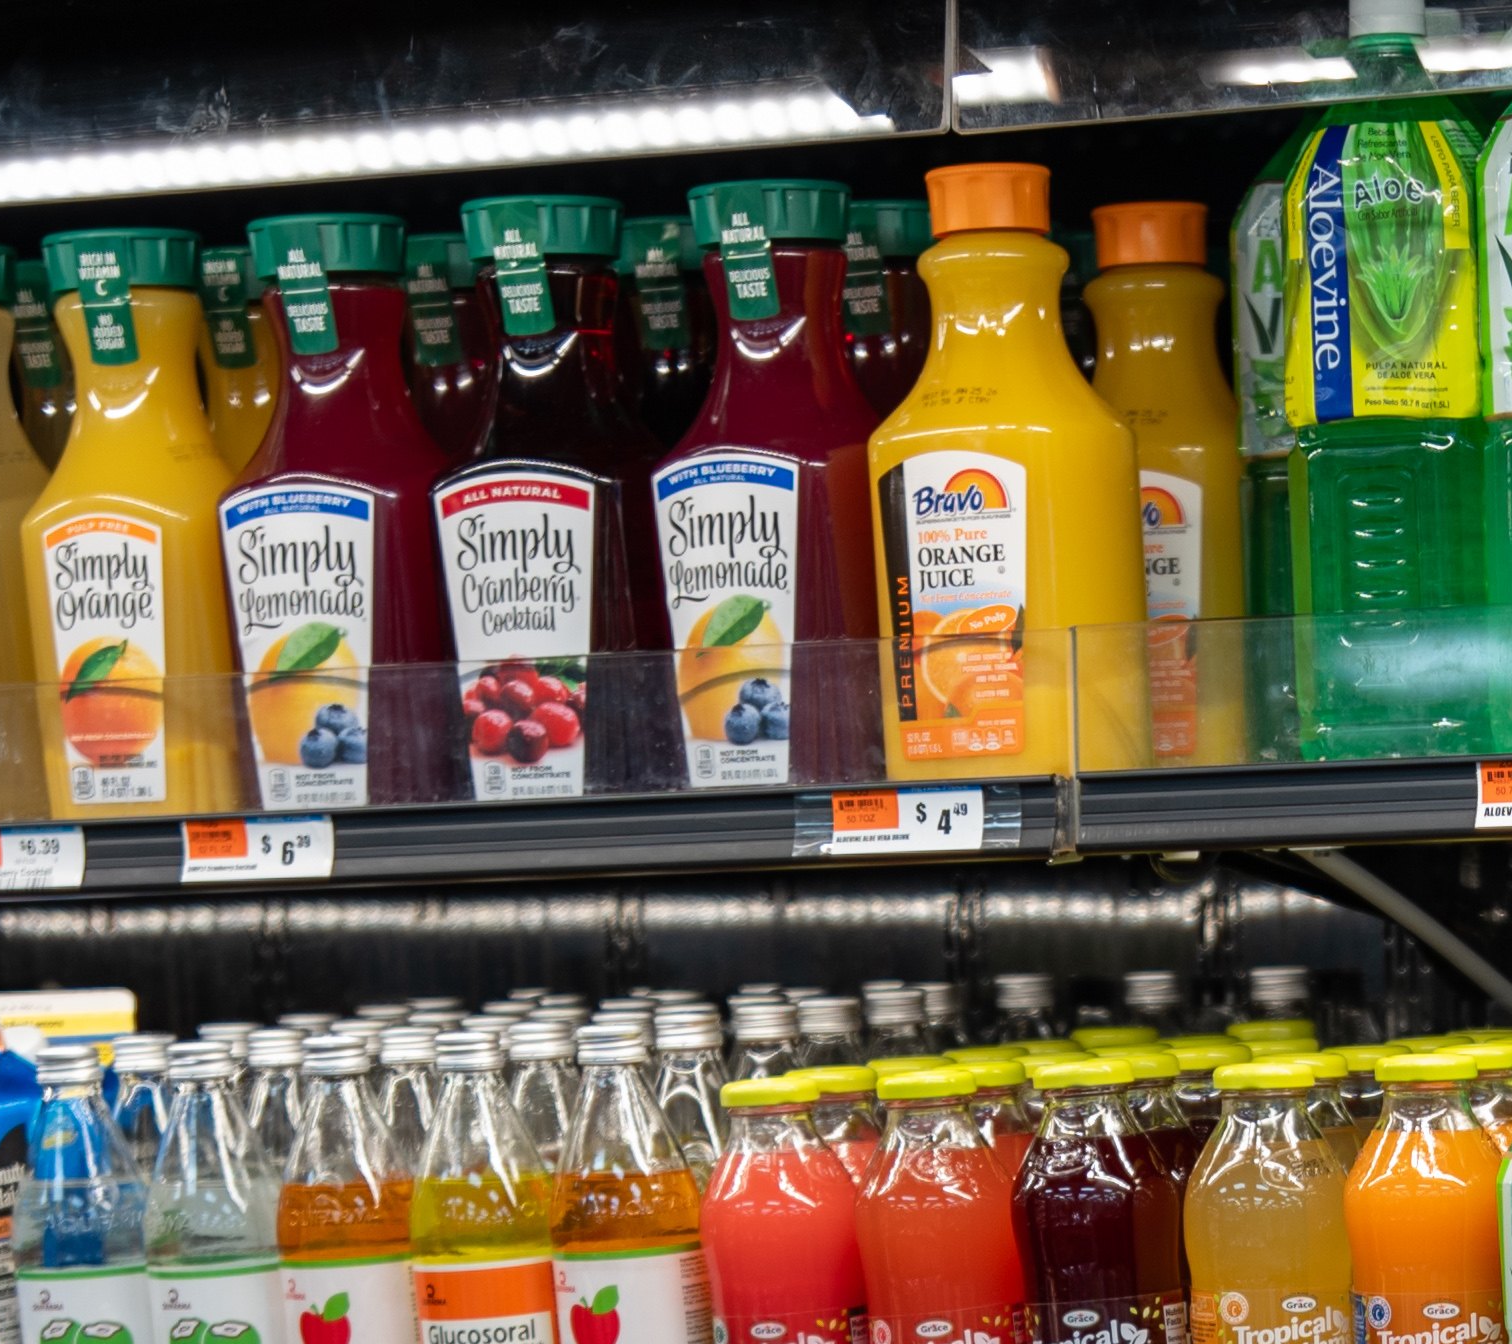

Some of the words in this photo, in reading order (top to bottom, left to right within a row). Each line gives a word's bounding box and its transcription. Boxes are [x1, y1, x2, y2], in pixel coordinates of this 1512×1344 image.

[1307, 161, 1346, 371] Aloevine
[1366, 361, 1394, 371] PULPA
[1399, 360, 1448, 371] NATURAL
[462, 489, 488, 504] ALL
[492, 486, 561, 501] NATURAL
[458, 514, 582, 575] Simply
[917, 529, 949, 545] 100%
[954, 527, 987, 542] Pure
[918, 544, 1005, 566] ORANGE
[462, 570, 579, 612] Cranberry
[919, 569, 976, 589] JUICE
[482, 603, 556, 636] Cocktail
[897, 577, 913, 709] PREMIUM
